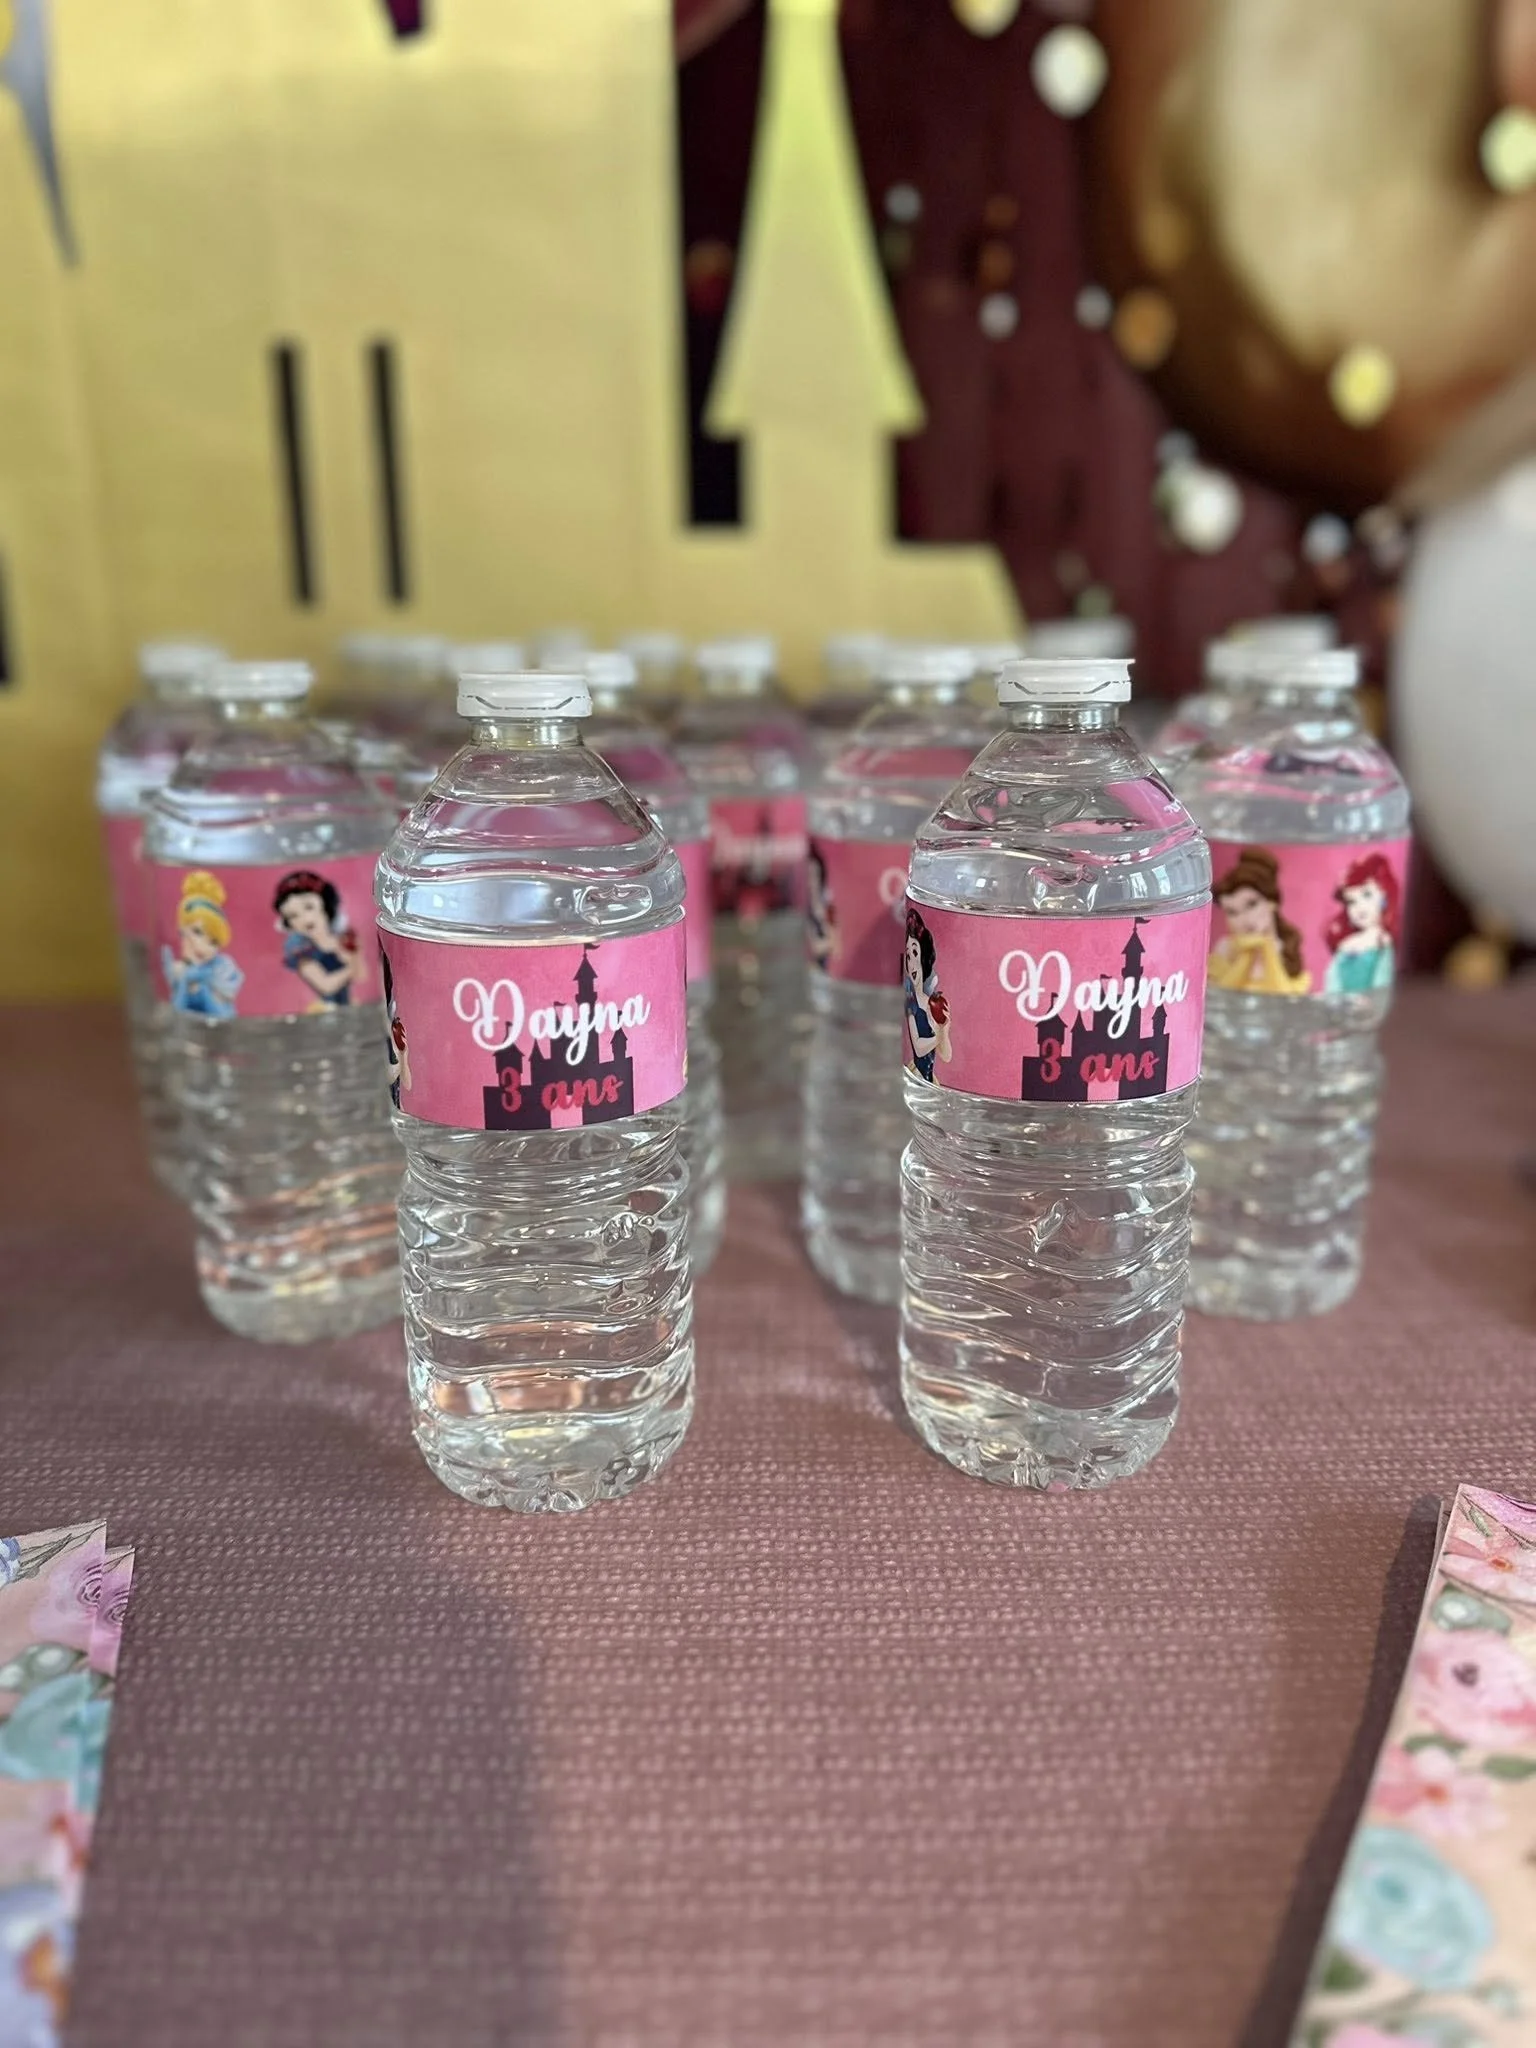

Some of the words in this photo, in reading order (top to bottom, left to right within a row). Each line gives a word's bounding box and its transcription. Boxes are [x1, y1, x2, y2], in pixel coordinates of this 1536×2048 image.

[452, 977, 651, 1066] Dayna
[998, 949, 1189, 1039] Dayna
[500, 1066, 522, 1113] 3
[541, 1073, 624, 1111] ans
[1040, 1037, 1062, 1083] 3
[1079, 1049, 1160, 1082] ans
